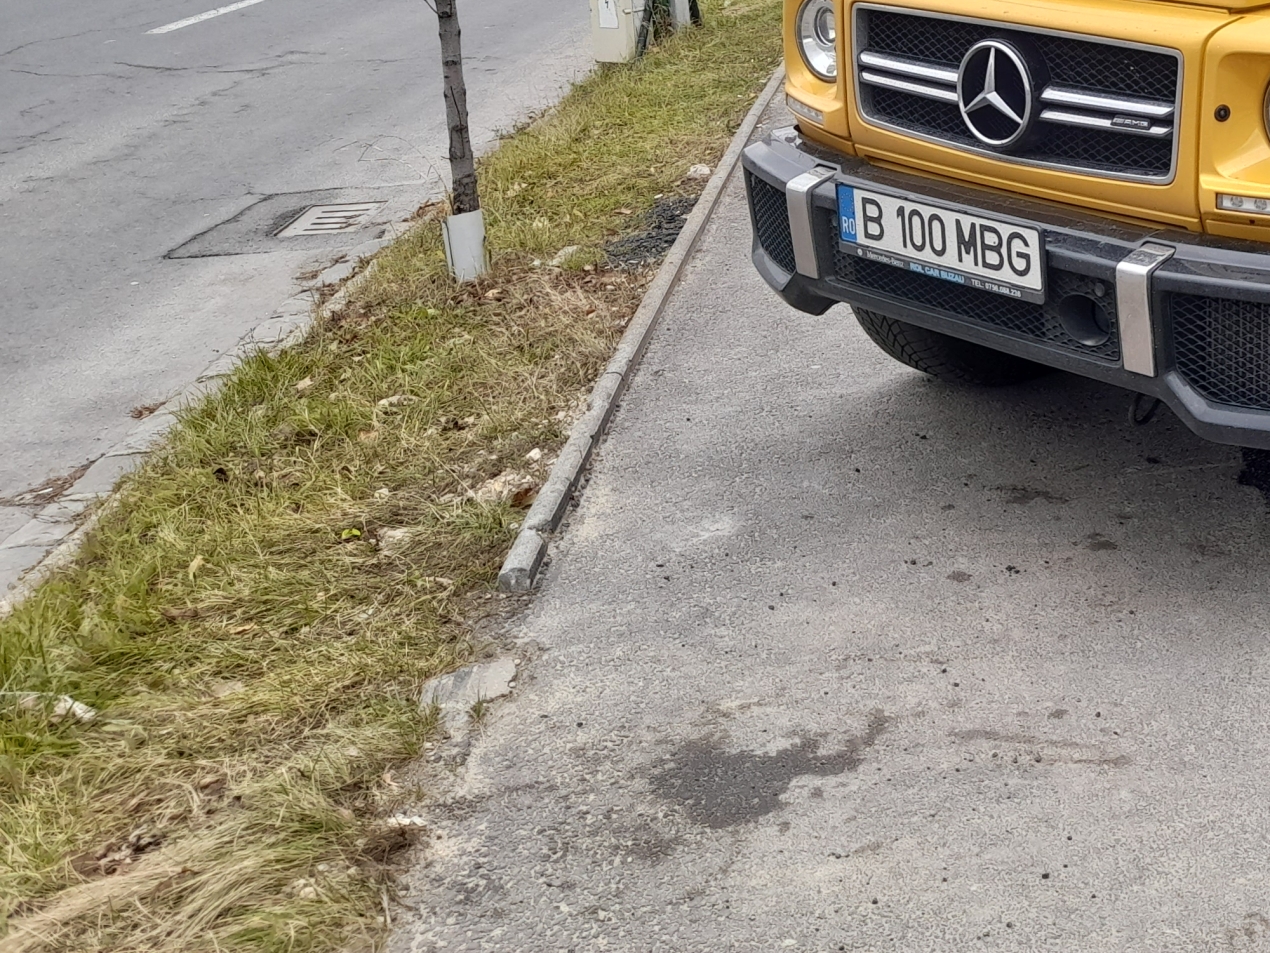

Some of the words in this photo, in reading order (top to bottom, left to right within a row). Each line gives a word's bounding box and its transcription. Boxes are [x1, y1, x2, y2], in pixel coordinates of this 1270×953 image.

[842, 215, 857, 235] RO
[861, 196, 885, 241] B
[896, 205, 947, 257] 100
[955, 218, 1031, 277] MBG
[866, 250, 905, 268] Mercedes-Benz
[925, 266, 940, 278] CAR
[940, 270, 965, 284] BUZAU
